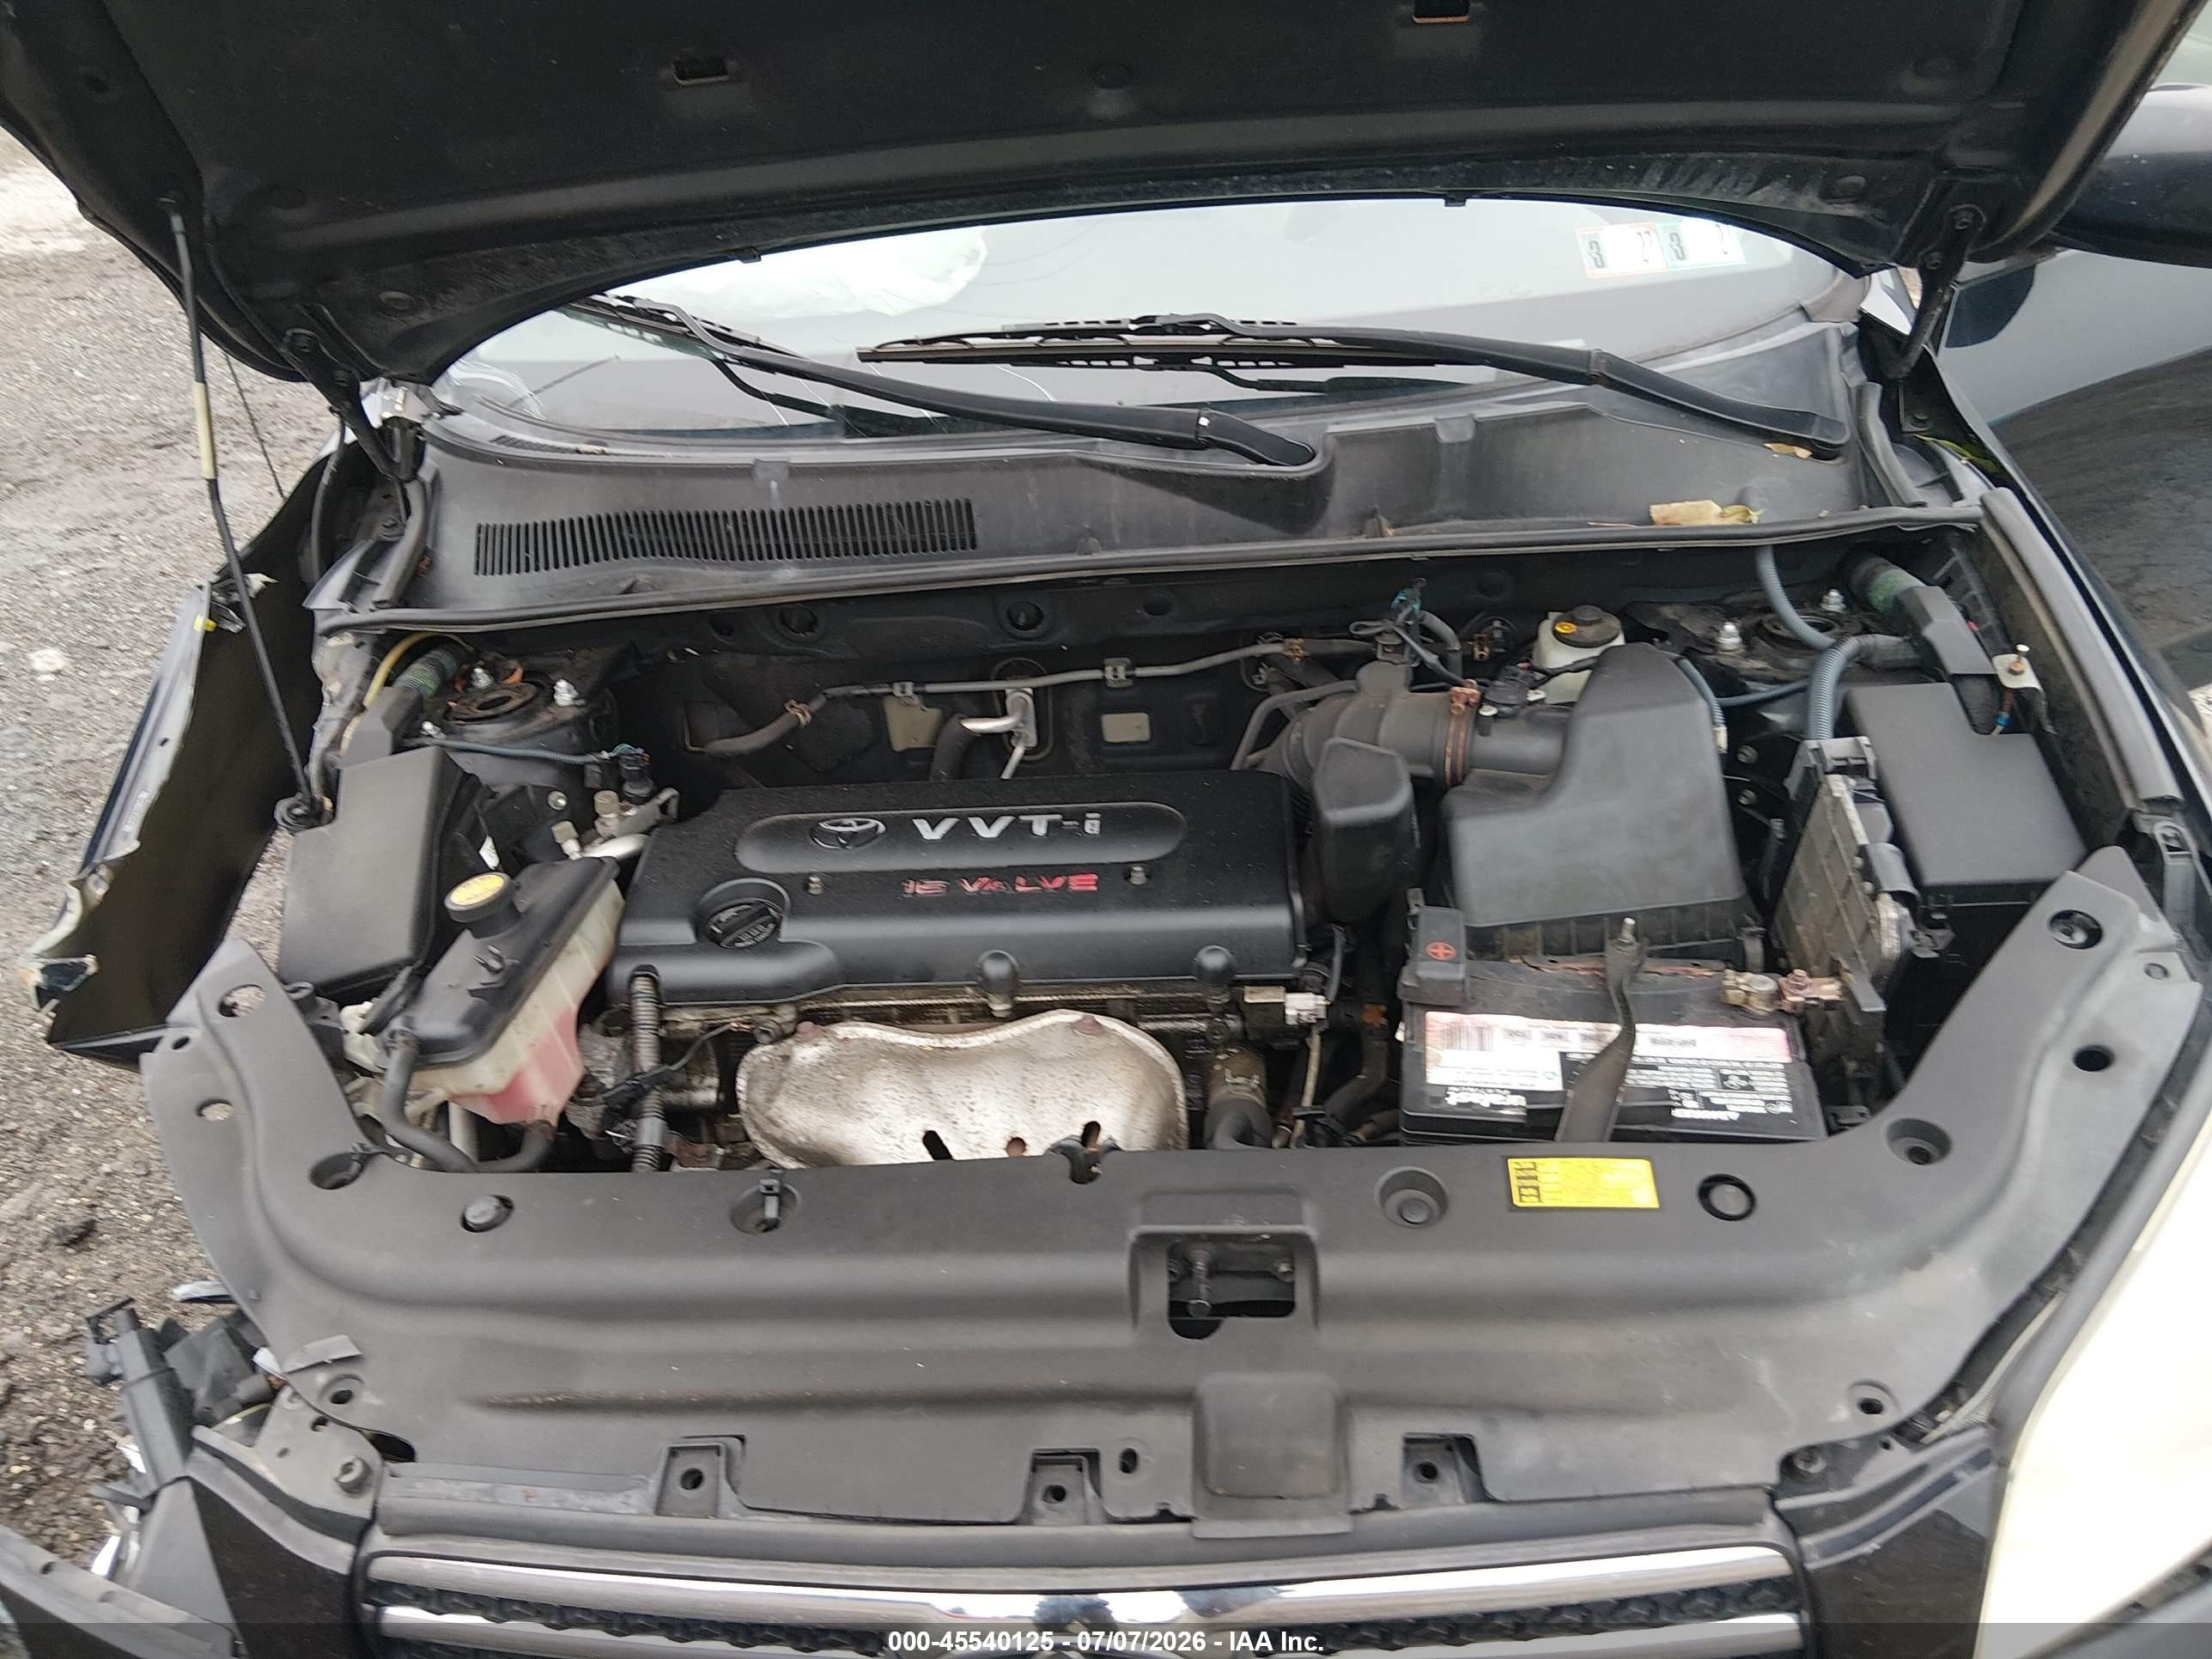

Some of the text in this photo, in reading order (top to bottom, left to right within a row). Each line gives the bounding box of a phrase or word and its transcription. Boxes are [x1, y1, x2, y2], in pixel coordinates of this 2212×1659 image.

[1588, 240, 1605, 269] 3
[1668, 232, 1686, 261] 3
[912, 812, 1102, 841] VVT-i
[958, 871, 1099, 896] VALVE
